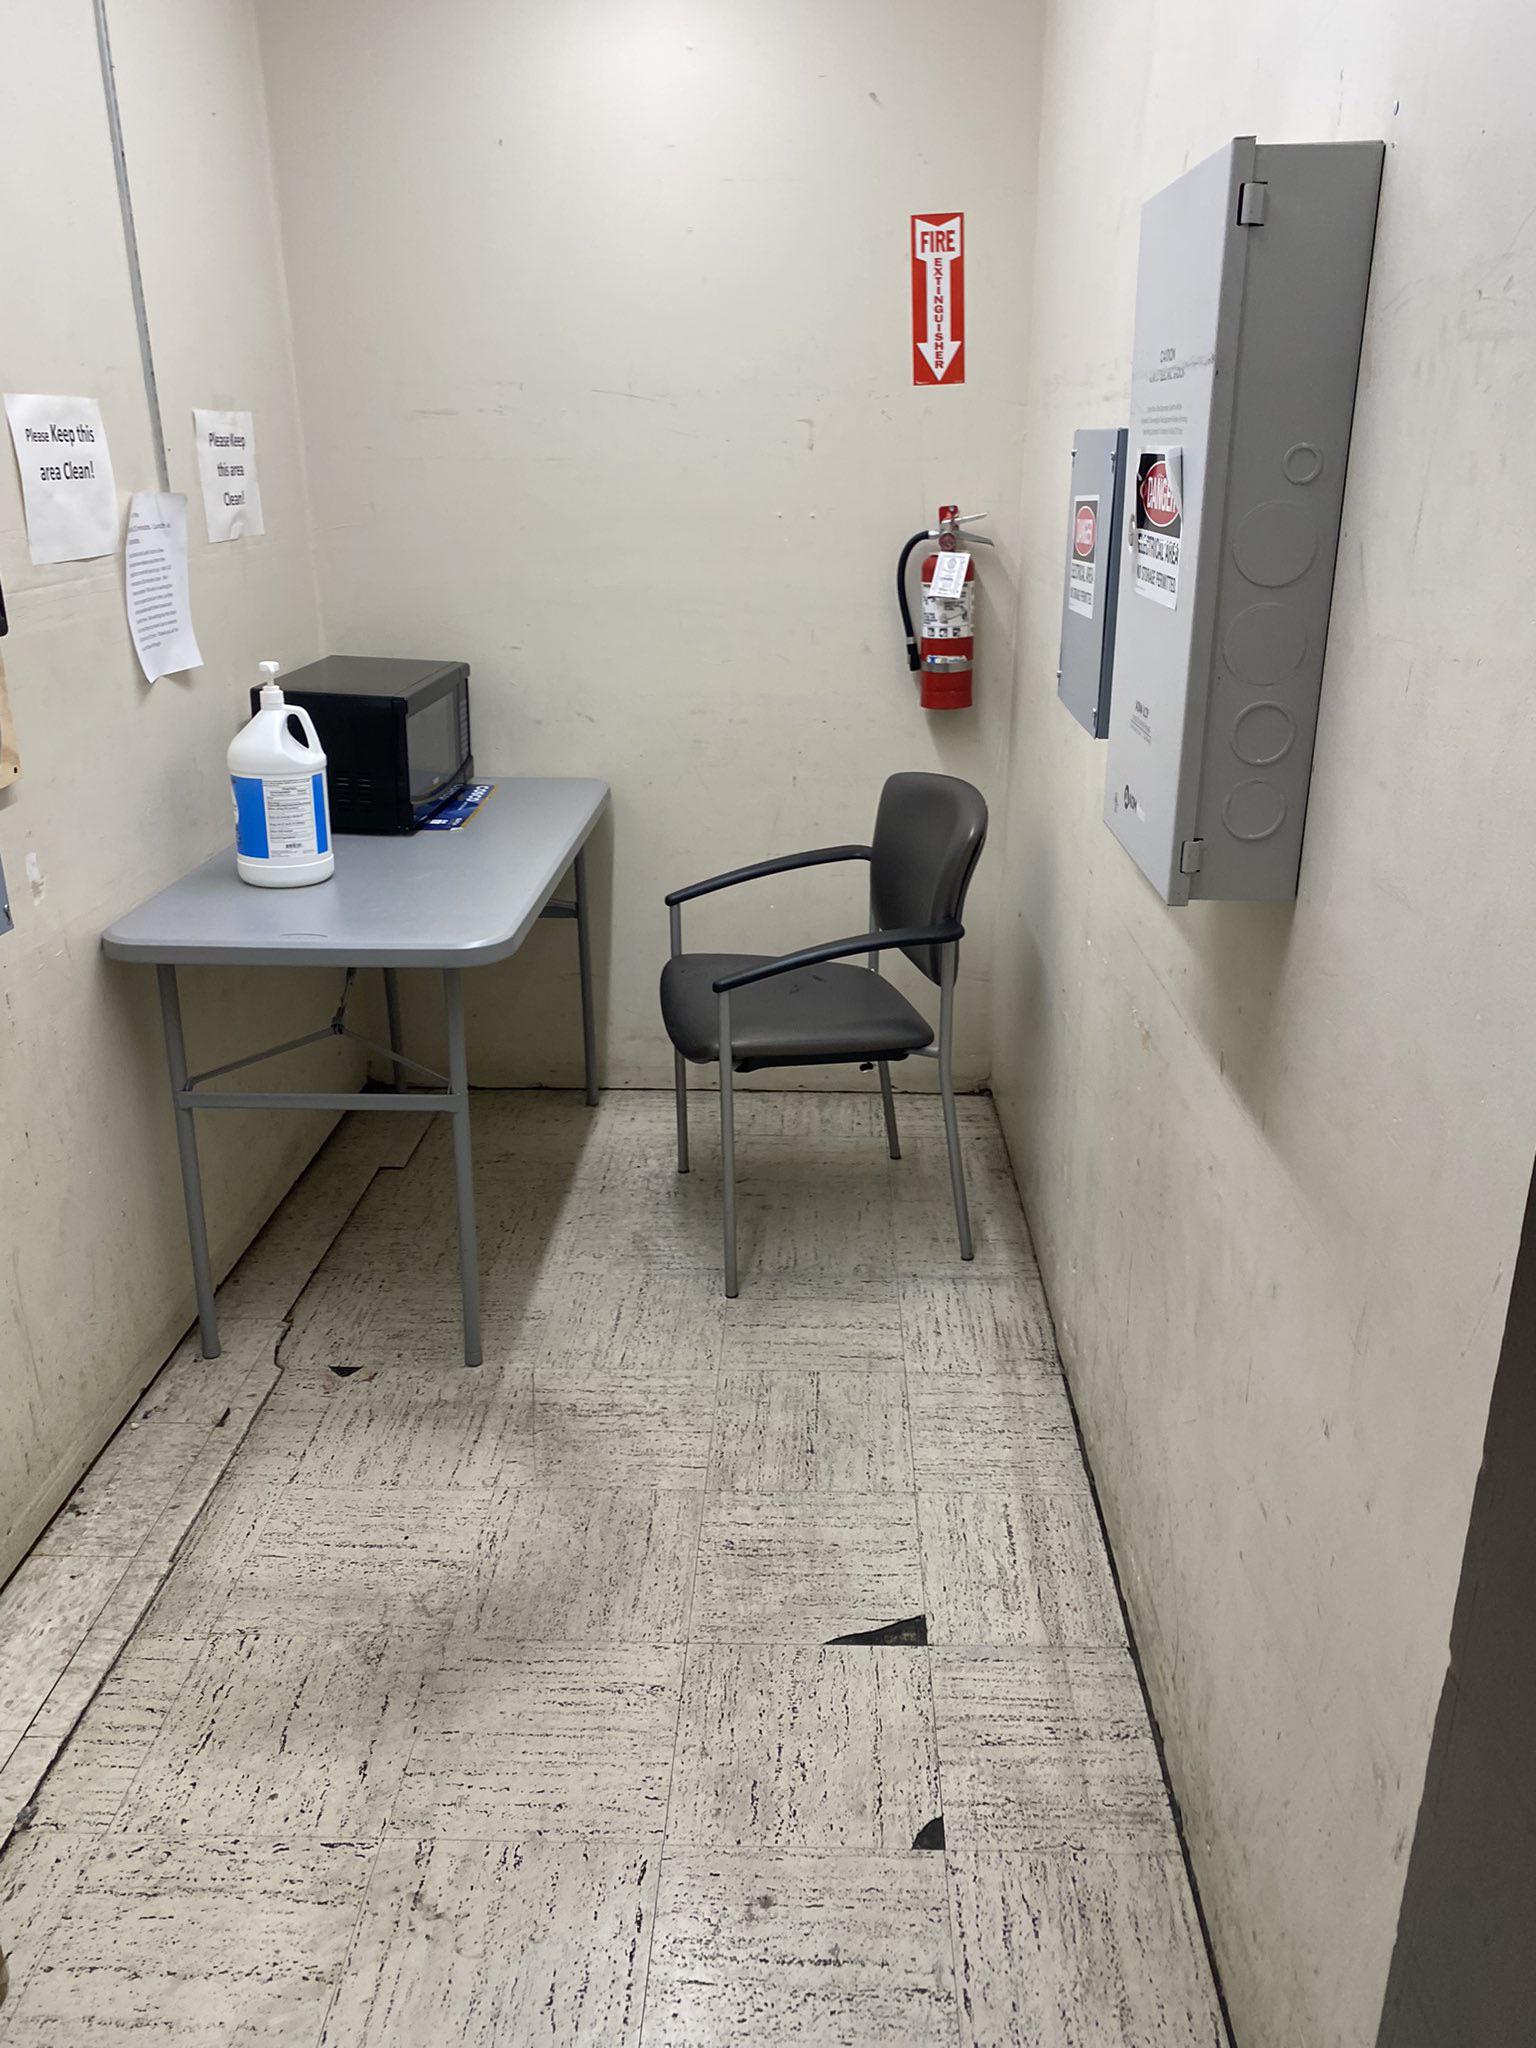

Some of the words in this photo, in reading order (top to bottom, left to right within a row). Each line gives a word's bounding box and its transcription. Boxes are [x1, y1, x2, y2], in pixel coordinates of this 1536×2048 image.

[920, 230, 956, 253] FIRE
[933, 257, 945, 369] EXTINGUISHER
[25, 427, 49, 442] Please
[50, 423, 76, 447] Keep
[76, 423, 95, 443] this
[209, 432, 230, 447] Please
[230, 433, 246, 451] Keep
[40, 466, 62, 481] area
[63, 460, 96, 480] Clean!
